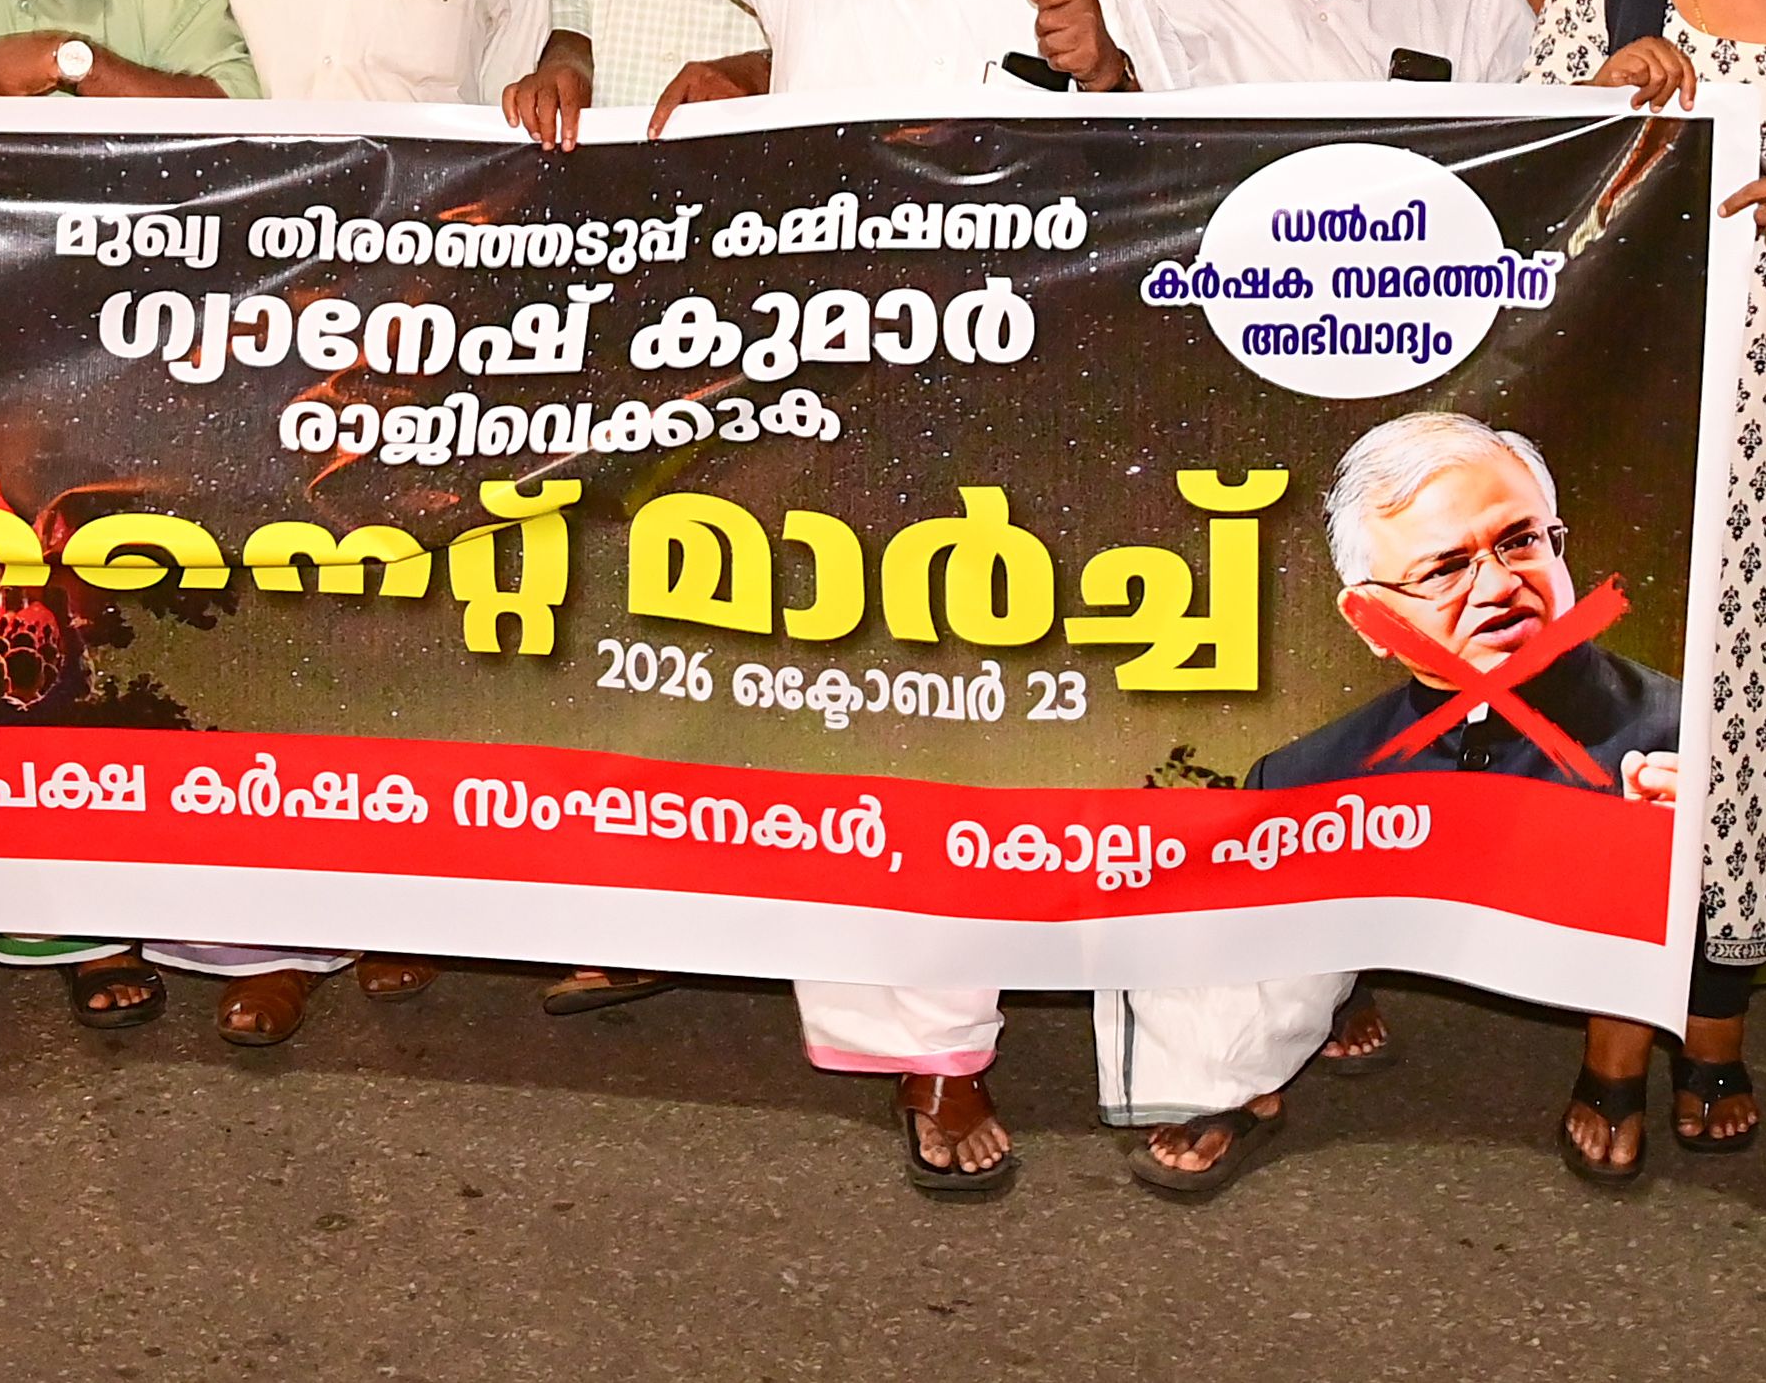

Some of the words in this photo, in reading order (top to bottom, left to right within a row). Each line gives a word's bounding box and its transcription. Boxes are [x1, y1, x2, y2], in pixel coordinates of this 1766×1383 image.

[55, 213, 221, 270] മുഖ്യ
[248, 203, 703, 276] തിരഞ്ഞെടുപ്പ്
[711, 192, 1088, 257] കമ്മീഷണർ
[1272, 200, 1427, 243] ഡൽഹി
[1147, 262, 1314, 300] കർഷക
[1331, 255, 1558, 302] സമരത്തിന്
[99, 283, 613, 384] ഗ്യാനേഷ്
[630, 277, 1035, 382] കുമാർ
[1242, 313, 1453, 365] അഭിവാദ്യം
[278, 391, 841, 466] രാജിവെക്കുക
[627, 469, 1290, 691] മാർച്ച്
[597, 638, 713, 702] 2026
[732, 659, 1006, 730] ഒക്ടോബർ
[1026, 670, 1087, 721] 23
[170, 751, 429, 824] കർഷക
[452, 777, 903, 874] സംഘടനകൾ,
[945, 819, 1187, 892] കൊല്ലം
[1211, 793, 1432, 871] ഏരിയ
